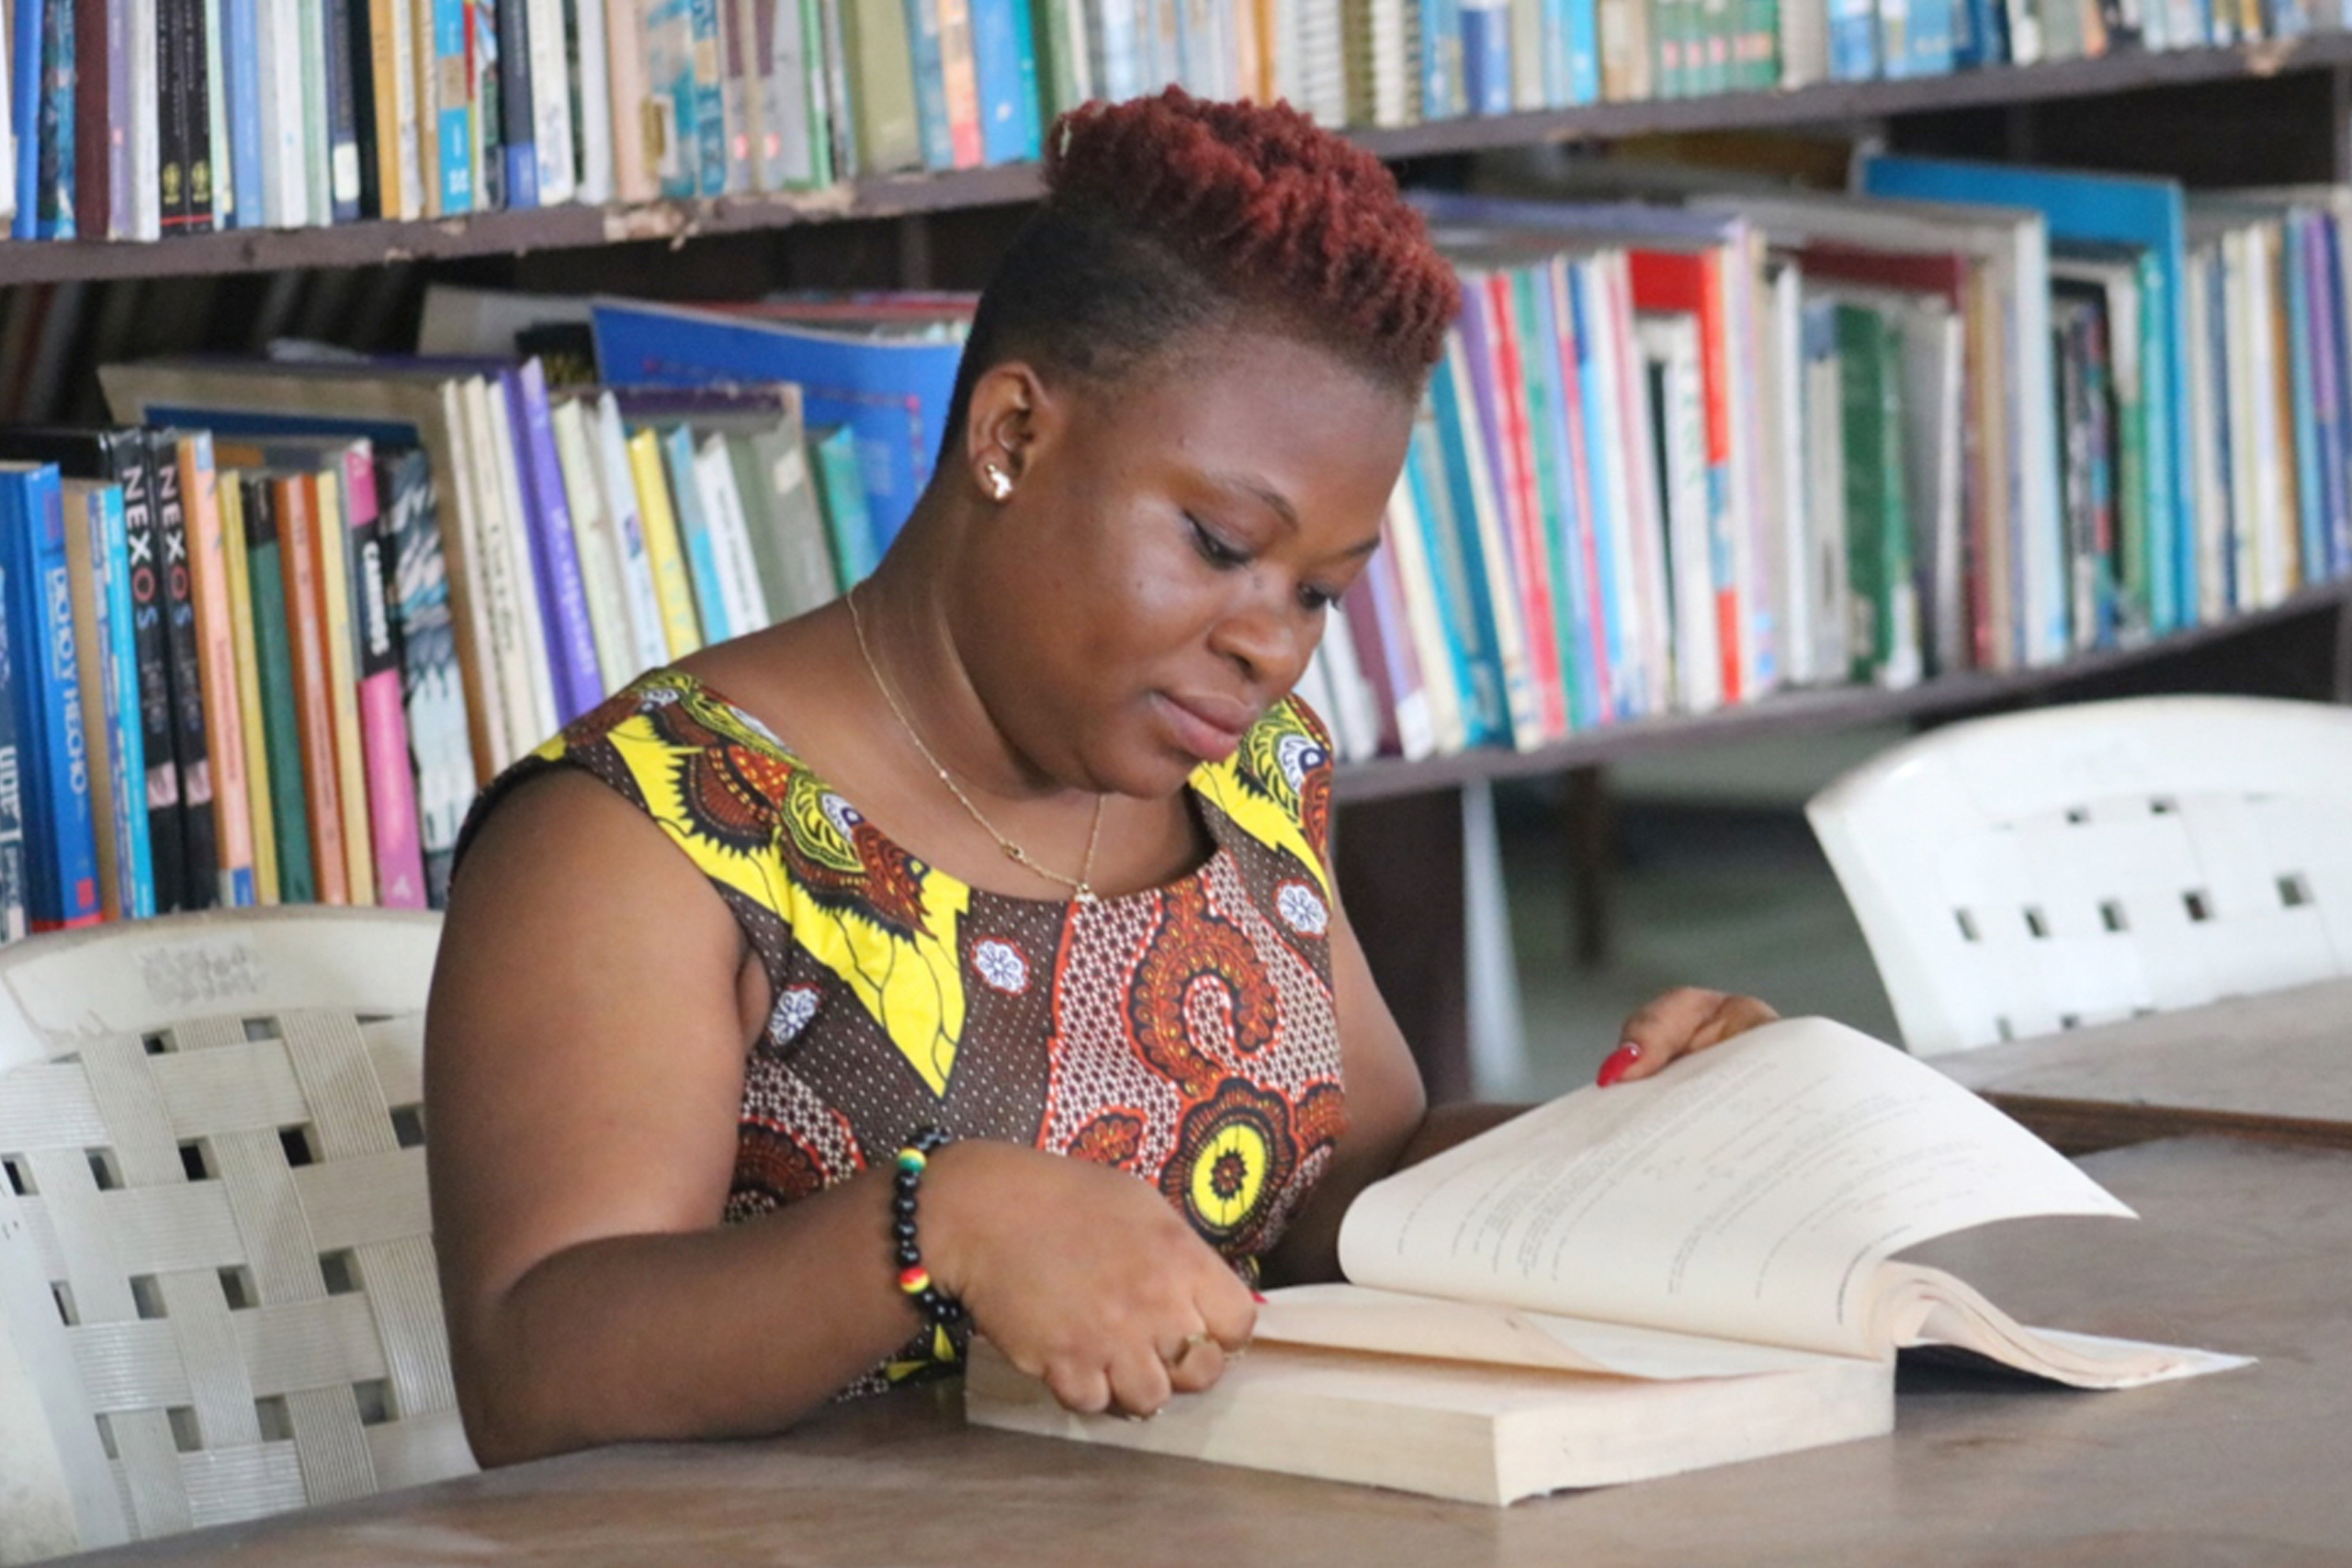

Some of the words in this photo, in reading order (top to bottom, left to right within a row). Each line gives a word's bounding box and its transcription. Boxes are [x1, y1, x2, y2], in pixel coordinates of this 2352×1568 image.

[122, 466, 159, 630] NEXOS
[159, 464, 193, 627] NEXOS
[52, 567, 75, 660] DICHO
[61, 660, 78, 681] Y
[62, 689, 87, 795] HECHO
